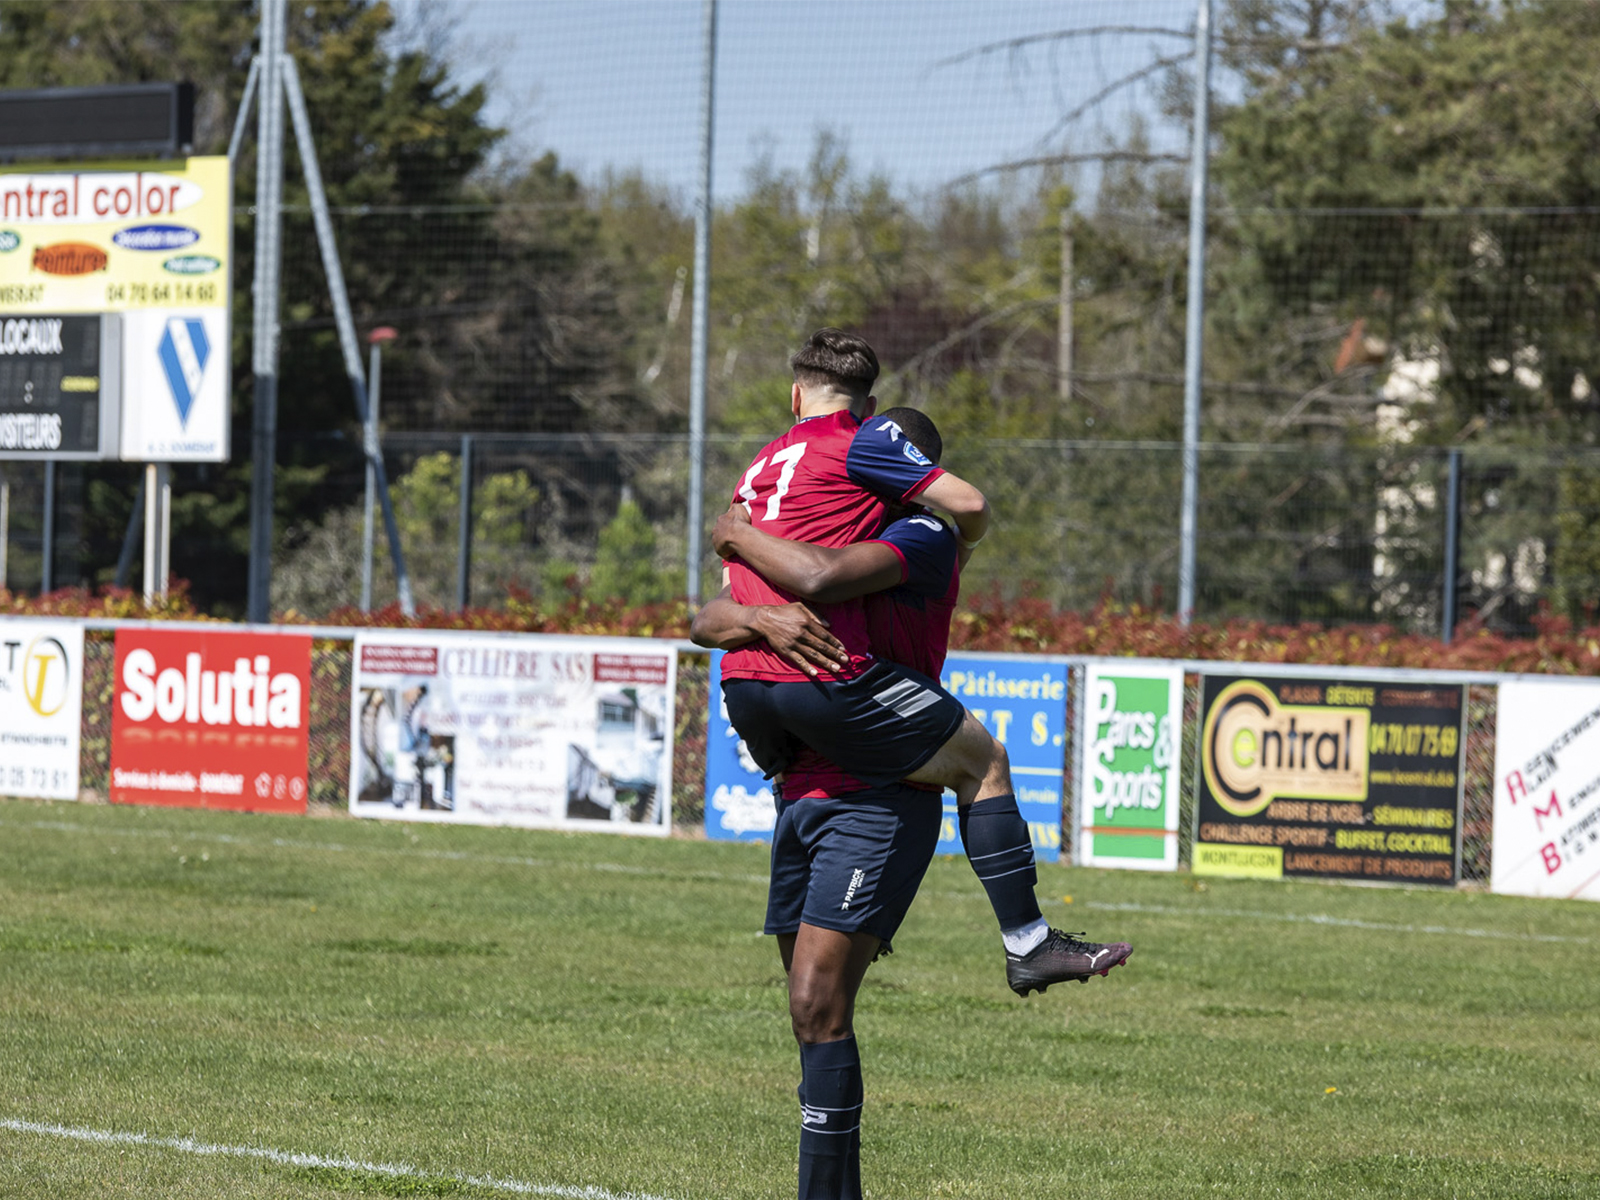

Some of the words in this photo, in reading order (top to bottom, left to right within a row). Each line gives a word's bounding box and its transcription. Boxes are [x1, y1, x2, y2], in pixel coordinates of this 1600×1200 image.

[93, 172, 181, 216] color
[120, 648, 302, 729] Solutia
[1093, 679, 1156, 749] Parcs
[1089, 737, 1164, 820] Sports
[844, 868, 863, 902] PATRICK
